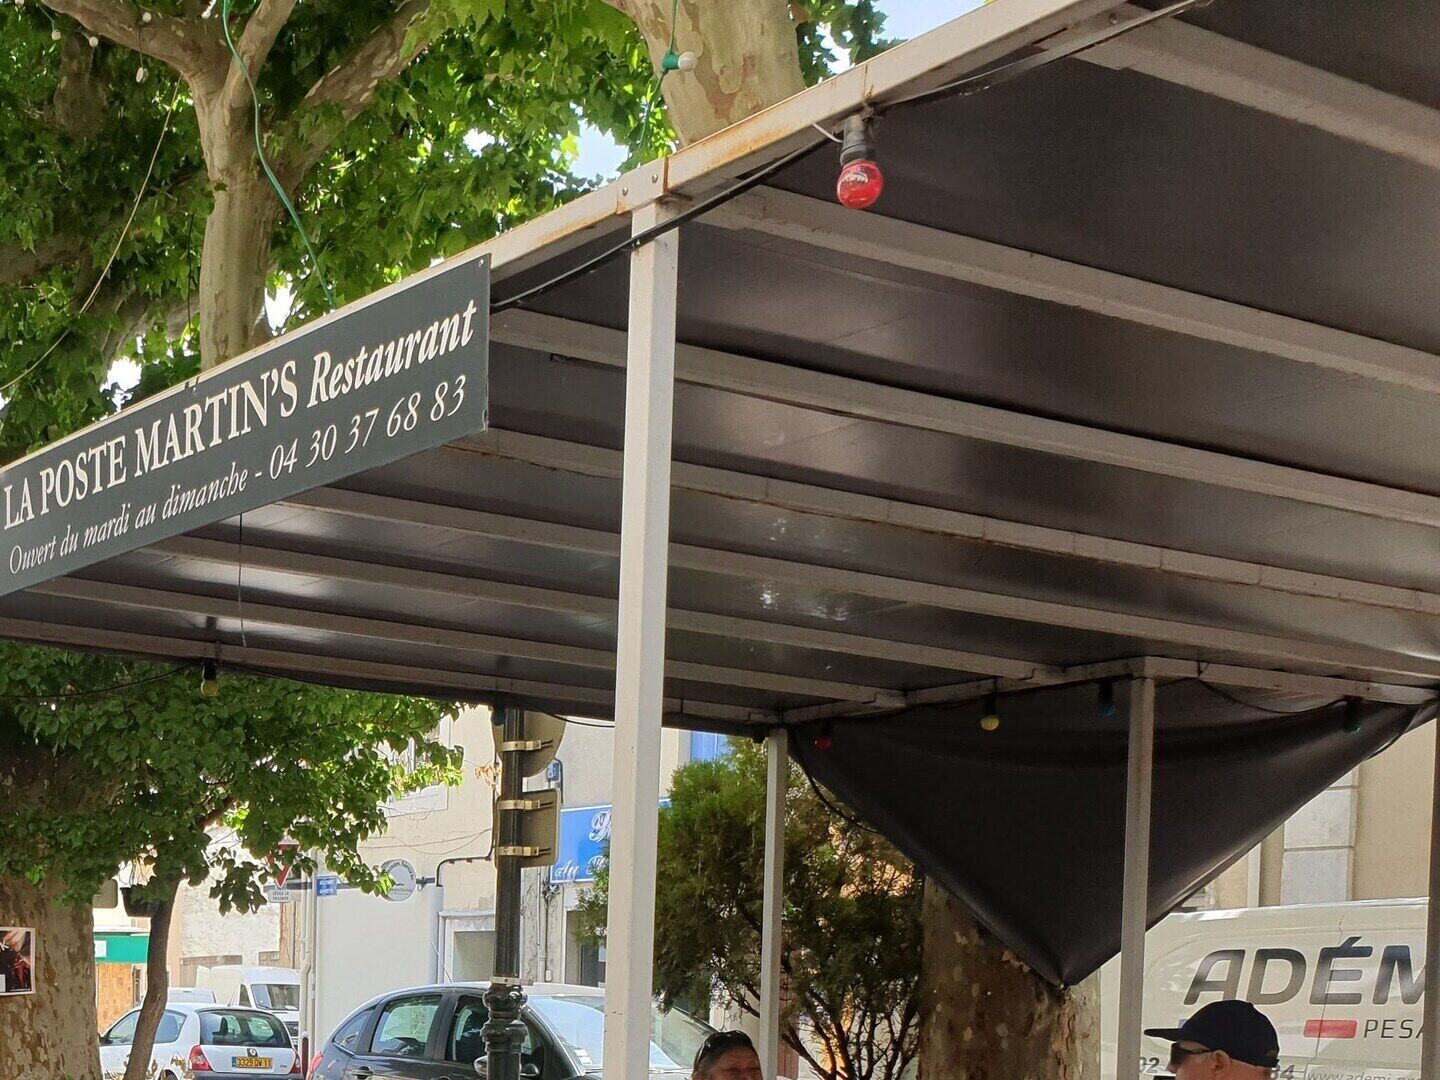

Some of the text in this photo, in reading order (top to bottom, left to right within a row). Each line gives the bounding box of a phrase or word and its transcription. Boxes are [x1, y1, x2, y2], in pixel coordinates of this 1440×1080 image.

[4, 299, 477, 530] LA POSTE MARTIN'S Restaurant
[9, 534, 57, 576] Ouvert
[59, 521, 80, 558] du
[82, 503, 131, 548] mardi
[135, 507, 157, 532] au
[161, 462, 248, 521] dimanche
[269, 443, 298, 480] 04
[306, 424, 338, 469] 30
[344, 407, 379, 455] 37
[386, 392, 421, 438] 68
[429, 374, 466, 424] 83
[1183, 936, 1426, 1006] ADÉM
